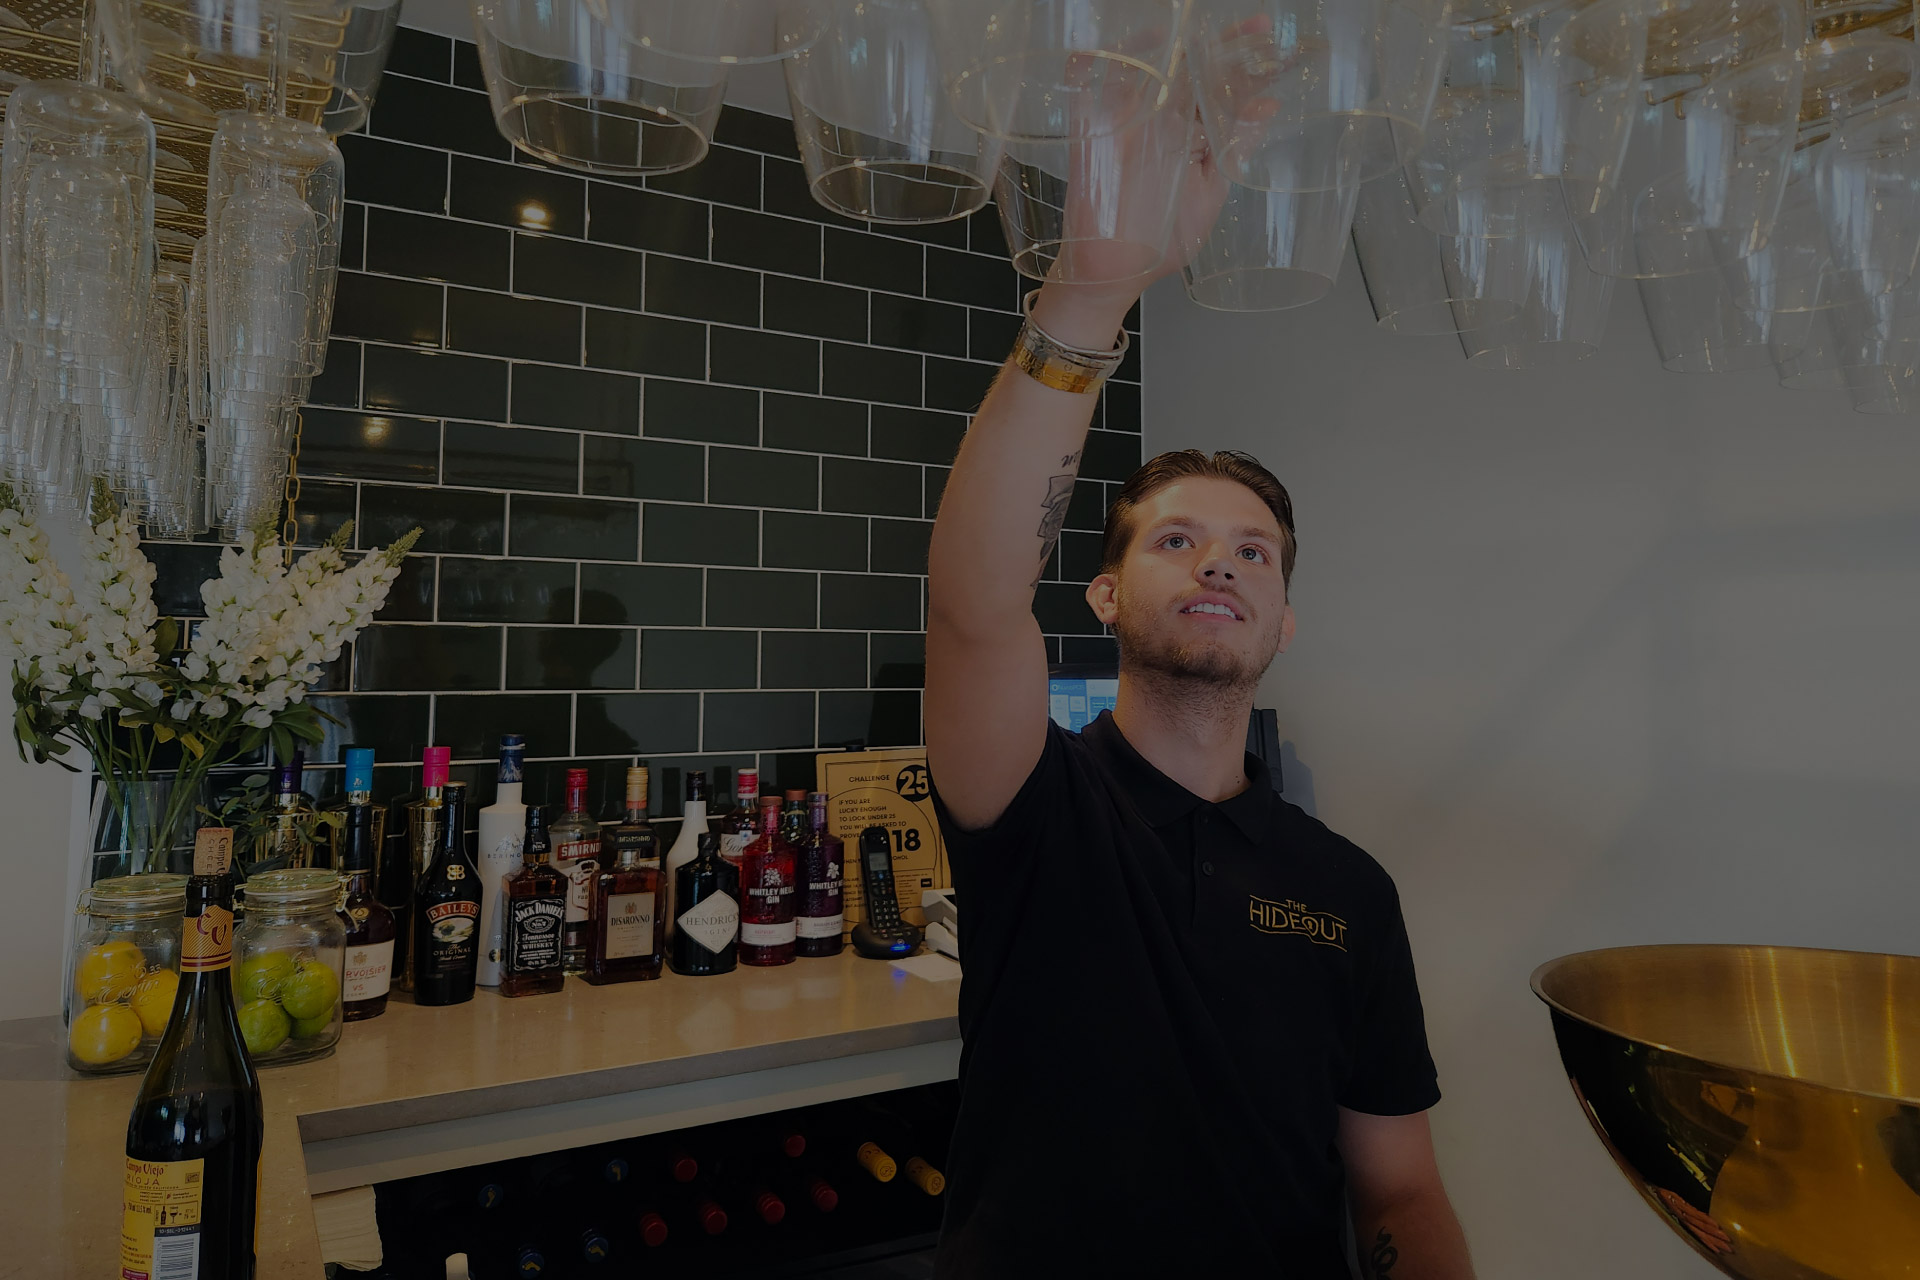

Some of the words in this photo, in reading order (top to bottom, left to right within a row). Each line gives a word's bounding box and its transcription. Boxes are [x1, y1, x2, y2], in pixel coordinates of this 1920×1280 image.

[848, 774, 890, 783] CHALLENGE
[898, 769, 929, 796] 25
[860, 805, 887, 813] ENOUGH
[892, 828, 921, 852] 18
[749, 887, 778, 896] WHITLEY
[809, 881, 838, 891] WHITLEY
[827, 888, 839, 897] GIN
[766, 895, 780, 905] GIN
[1285, 898, 1307, 913] THE
[430, 903, 478, 919] BAILEYS
[515, 904, 536, 922] JACK
[611, 914, 650, 926] DISARONNO
[1249, 900, 1348, 945] HIDEOUT
[433, 946, 472, 956] ORIGINAL
[522, 941, 554, 951] WHISKEY
[126, 1173, 160, 1186] RIOJA
